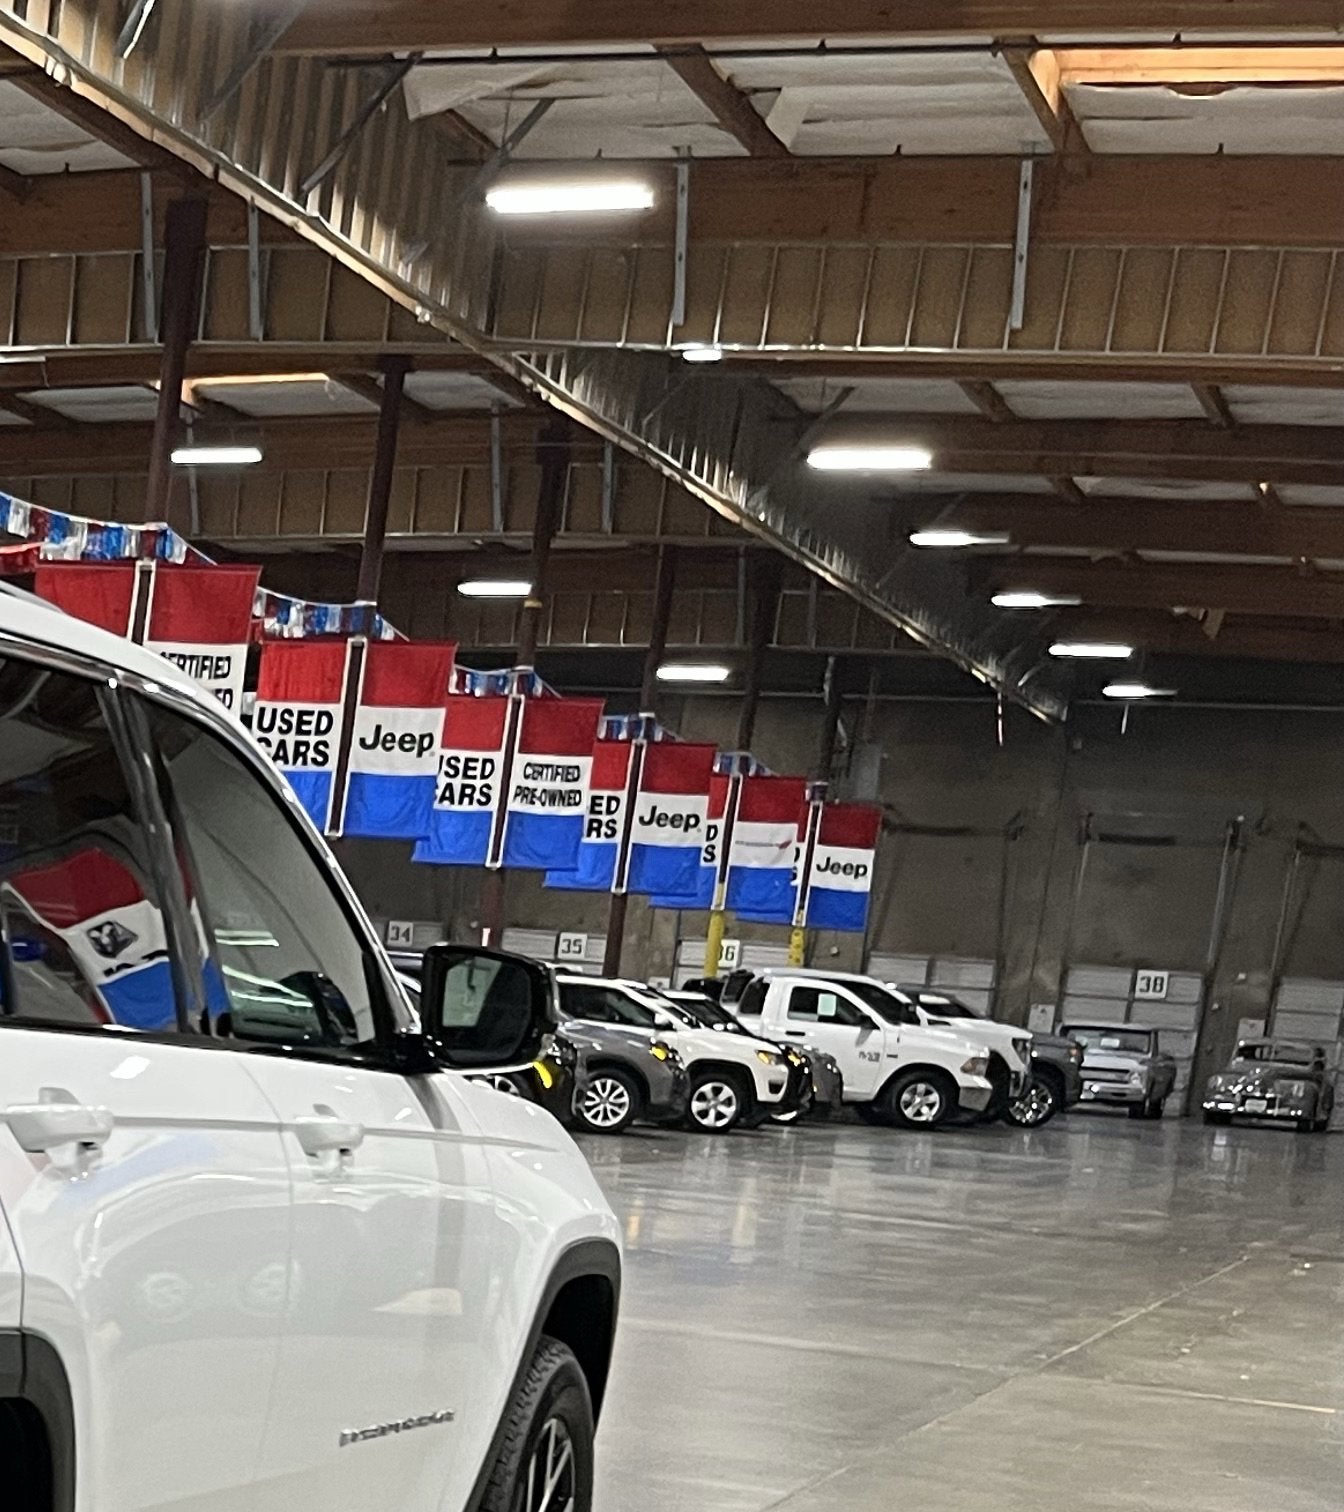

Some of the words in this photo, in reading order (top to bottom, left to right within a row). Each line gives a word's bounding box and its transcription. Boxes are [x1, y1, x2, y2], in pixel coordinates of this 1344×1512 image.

[160, 651, 232, 679] RTIFIED
[257, 707, 334, 737] USED
[359, 724, 435, 758] Jeep
[438, 755, 495, 780] SED
[524, 762, 581, 783] CERTIFIED
[435, 782, 493, 807] ARS
[512, 785, 582, 807] PRE-OWNED
[589, 795, 621, 815] ED
[586, 818, 618, 839] RS
[638, 806, 701, 833] Jeep
[816, 857, 868, 879] Jeep
[390, 926, 410, 942] 34
[561, 938, 582, 954] 35
[1139, 975, 1164, 992] 38
